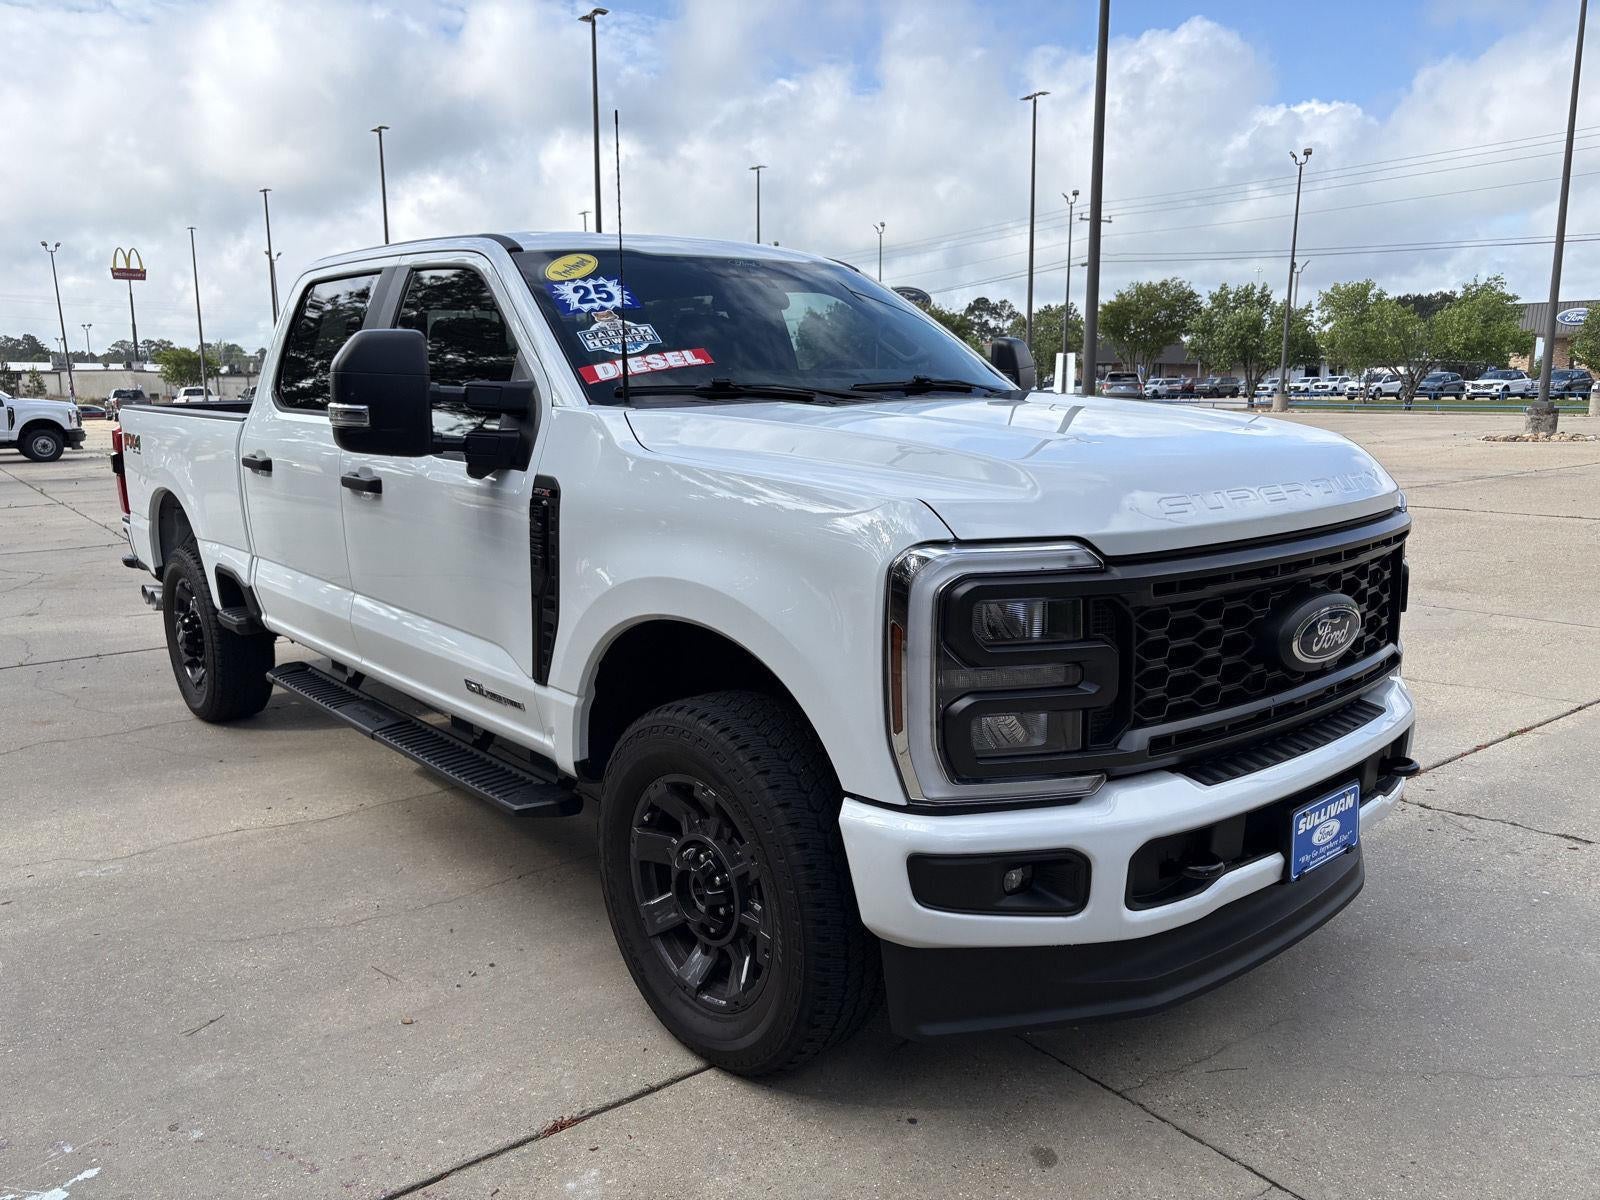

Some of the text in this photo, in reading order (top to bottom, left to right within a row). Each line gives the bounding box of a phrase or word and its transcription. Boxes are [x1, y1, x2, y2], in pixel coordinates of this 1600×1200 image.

[572, 283, 615, 305] 25
[601, 334, 655, 346] OWNER
[594, 350, 705, 380] DIESEL
[1157, 470, 1382, 514] SUPER DUTY
[1312, 616, 1350, 653] Ford
[1297, 793, 1355, 835] SULLIVAN
